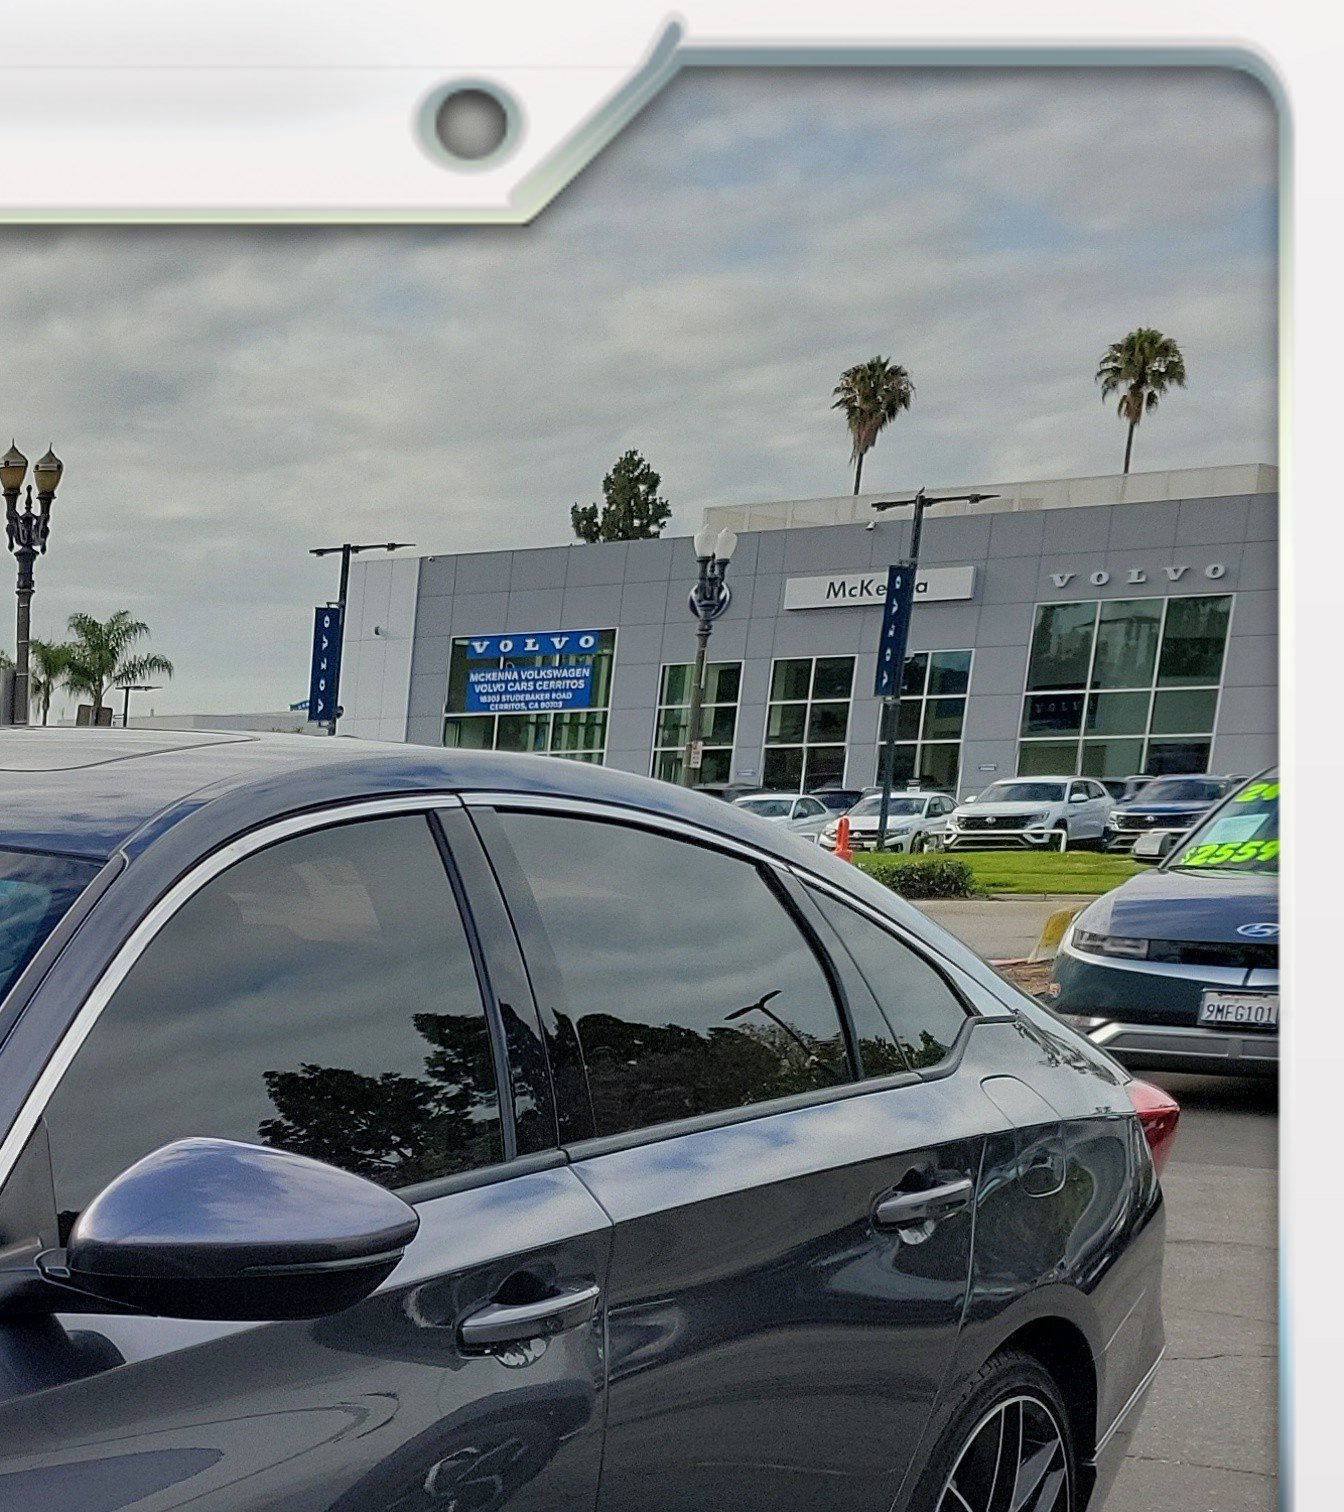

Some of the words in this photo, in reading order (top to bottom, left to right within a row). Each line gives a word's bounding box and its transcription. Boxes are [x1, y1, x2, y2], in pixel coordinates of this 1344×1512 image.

[1049, 563, 1226, 588] VOLVO
[825, 579, 928, 600] McKea
[471, 635, 595, 653] VOLVO
[469, 671, 518, 682] MCKENNA
[520, 668, 591, 680] VOLKSWAGEN
[474, 683, 505, 693] VOLVO
[507, 682, 534, 692] CARS
[535, 680, 585, 690] CERRITOS
[552, 691, 573, 700] ROAD
[1205, 1002, 1273, 1023] 9MFG101
